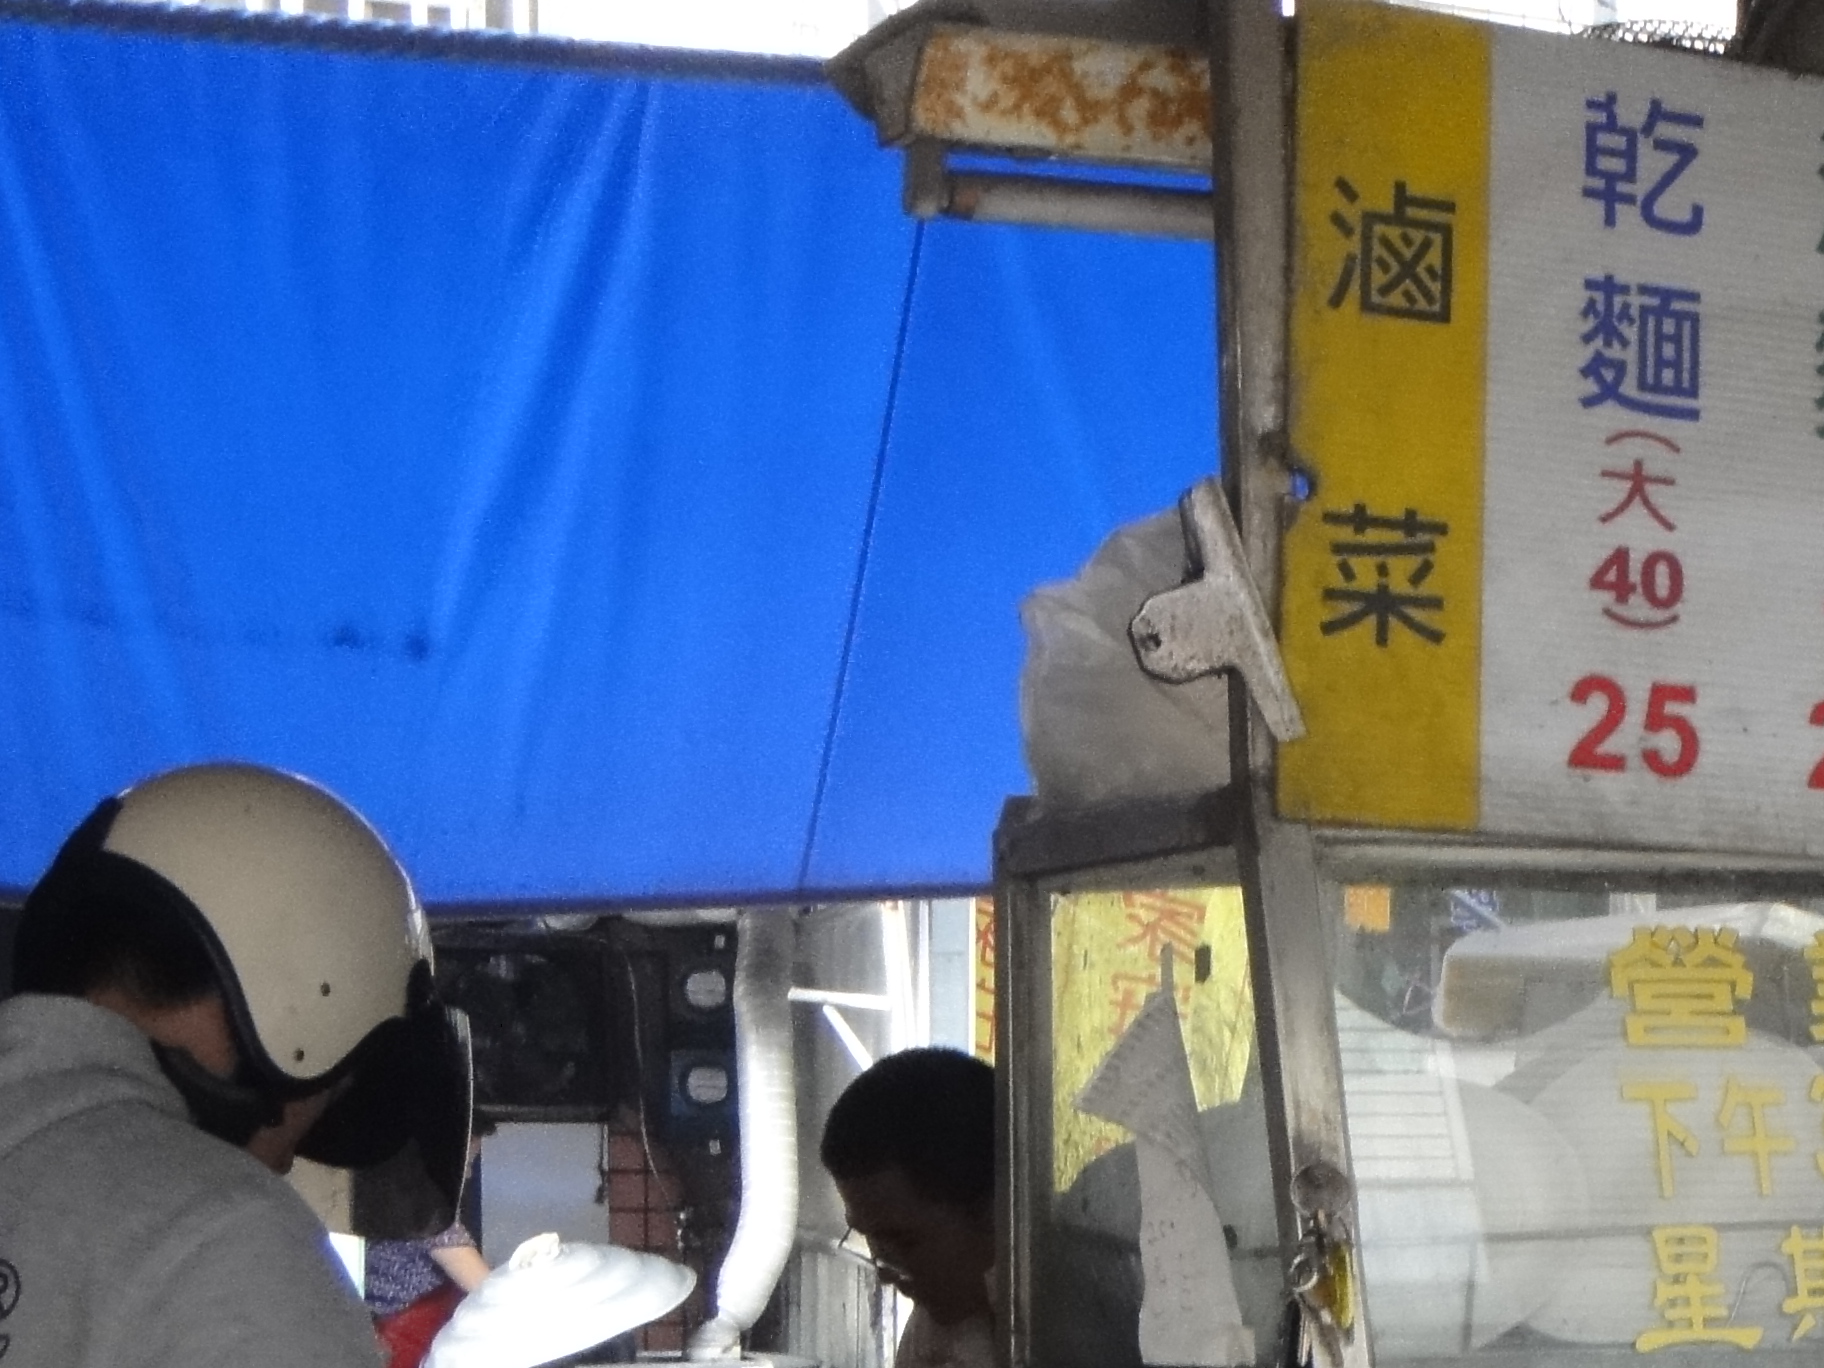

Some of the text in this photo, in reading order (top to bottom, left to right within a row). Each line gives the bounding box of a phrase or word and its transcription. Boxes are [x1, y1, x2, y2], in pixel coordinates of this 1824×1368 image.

[1319, 177, 1456, 647] 滷菜
[1578, 92, 1705, 422] 乾麵
[1567, 675, 1701, 780] 25
